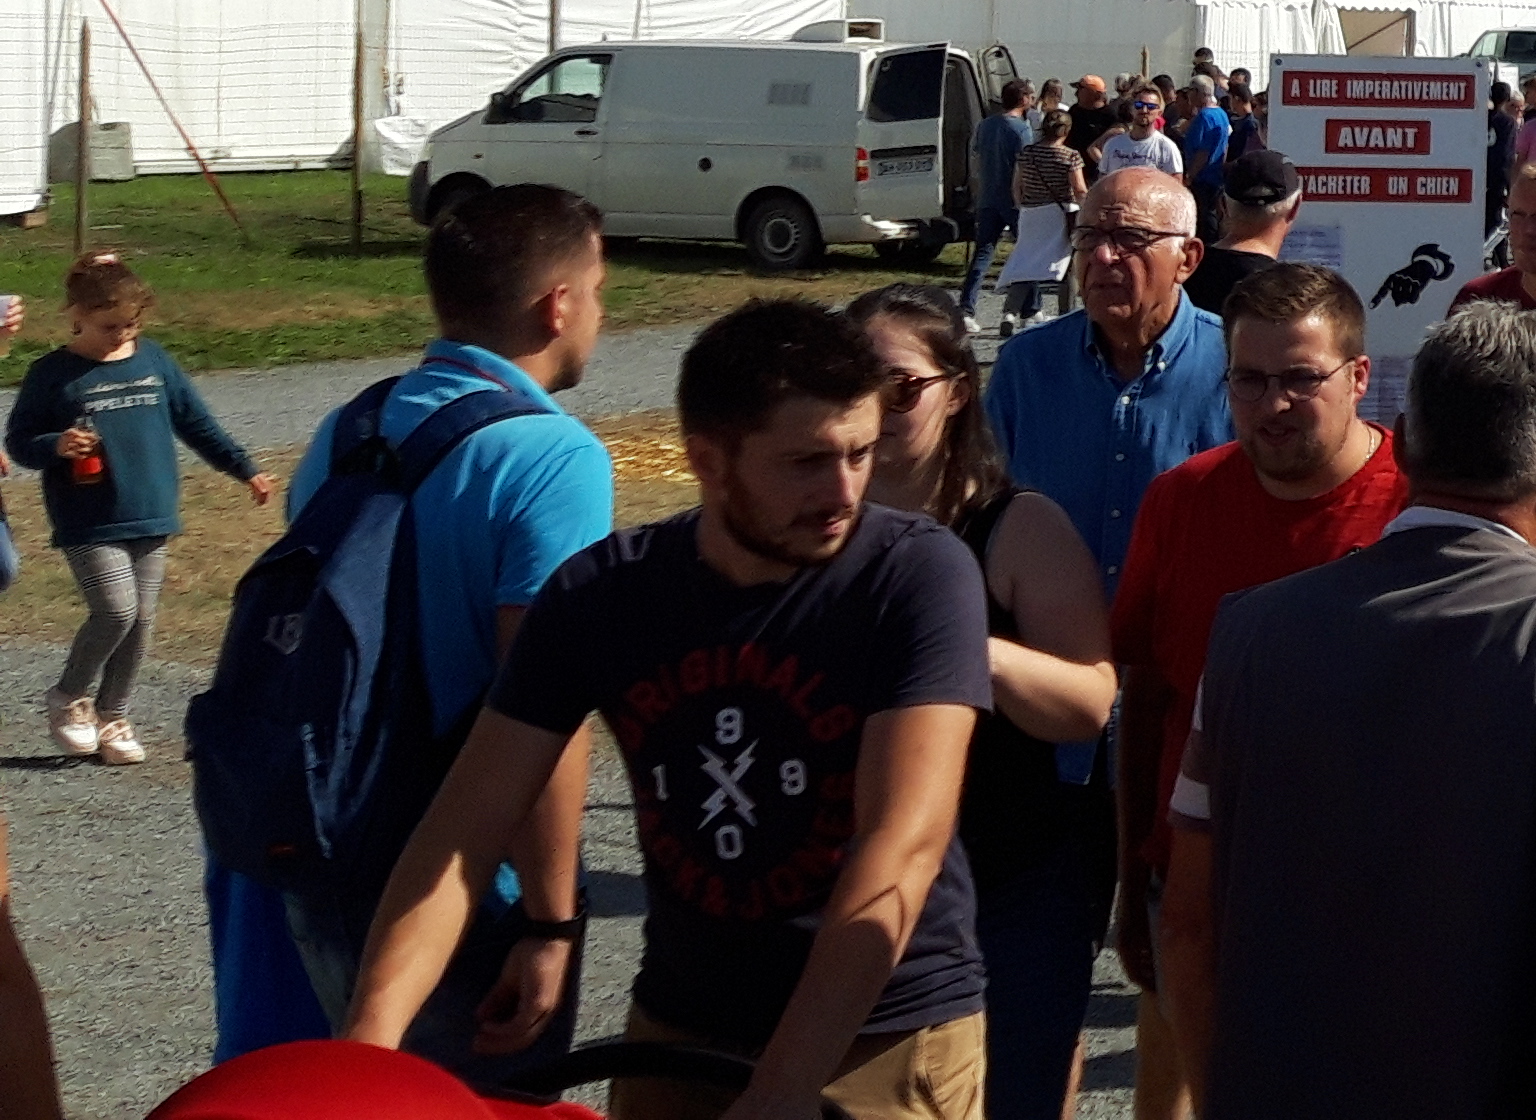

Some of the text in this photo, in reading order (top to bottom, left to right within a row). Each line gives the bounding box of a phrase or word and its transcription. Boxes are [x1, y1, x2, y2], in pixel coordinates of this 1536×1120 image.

[1291, 78, 1467, 101] A LIRE IMPERATIVEMENT
[1338, 127, 1418, 148] AVANT
[1388, 177, 1408, 195] UN
[1417, 176, 1459, 196] CHIEN
[651, 706, 808, 860] 1 9 9 0
